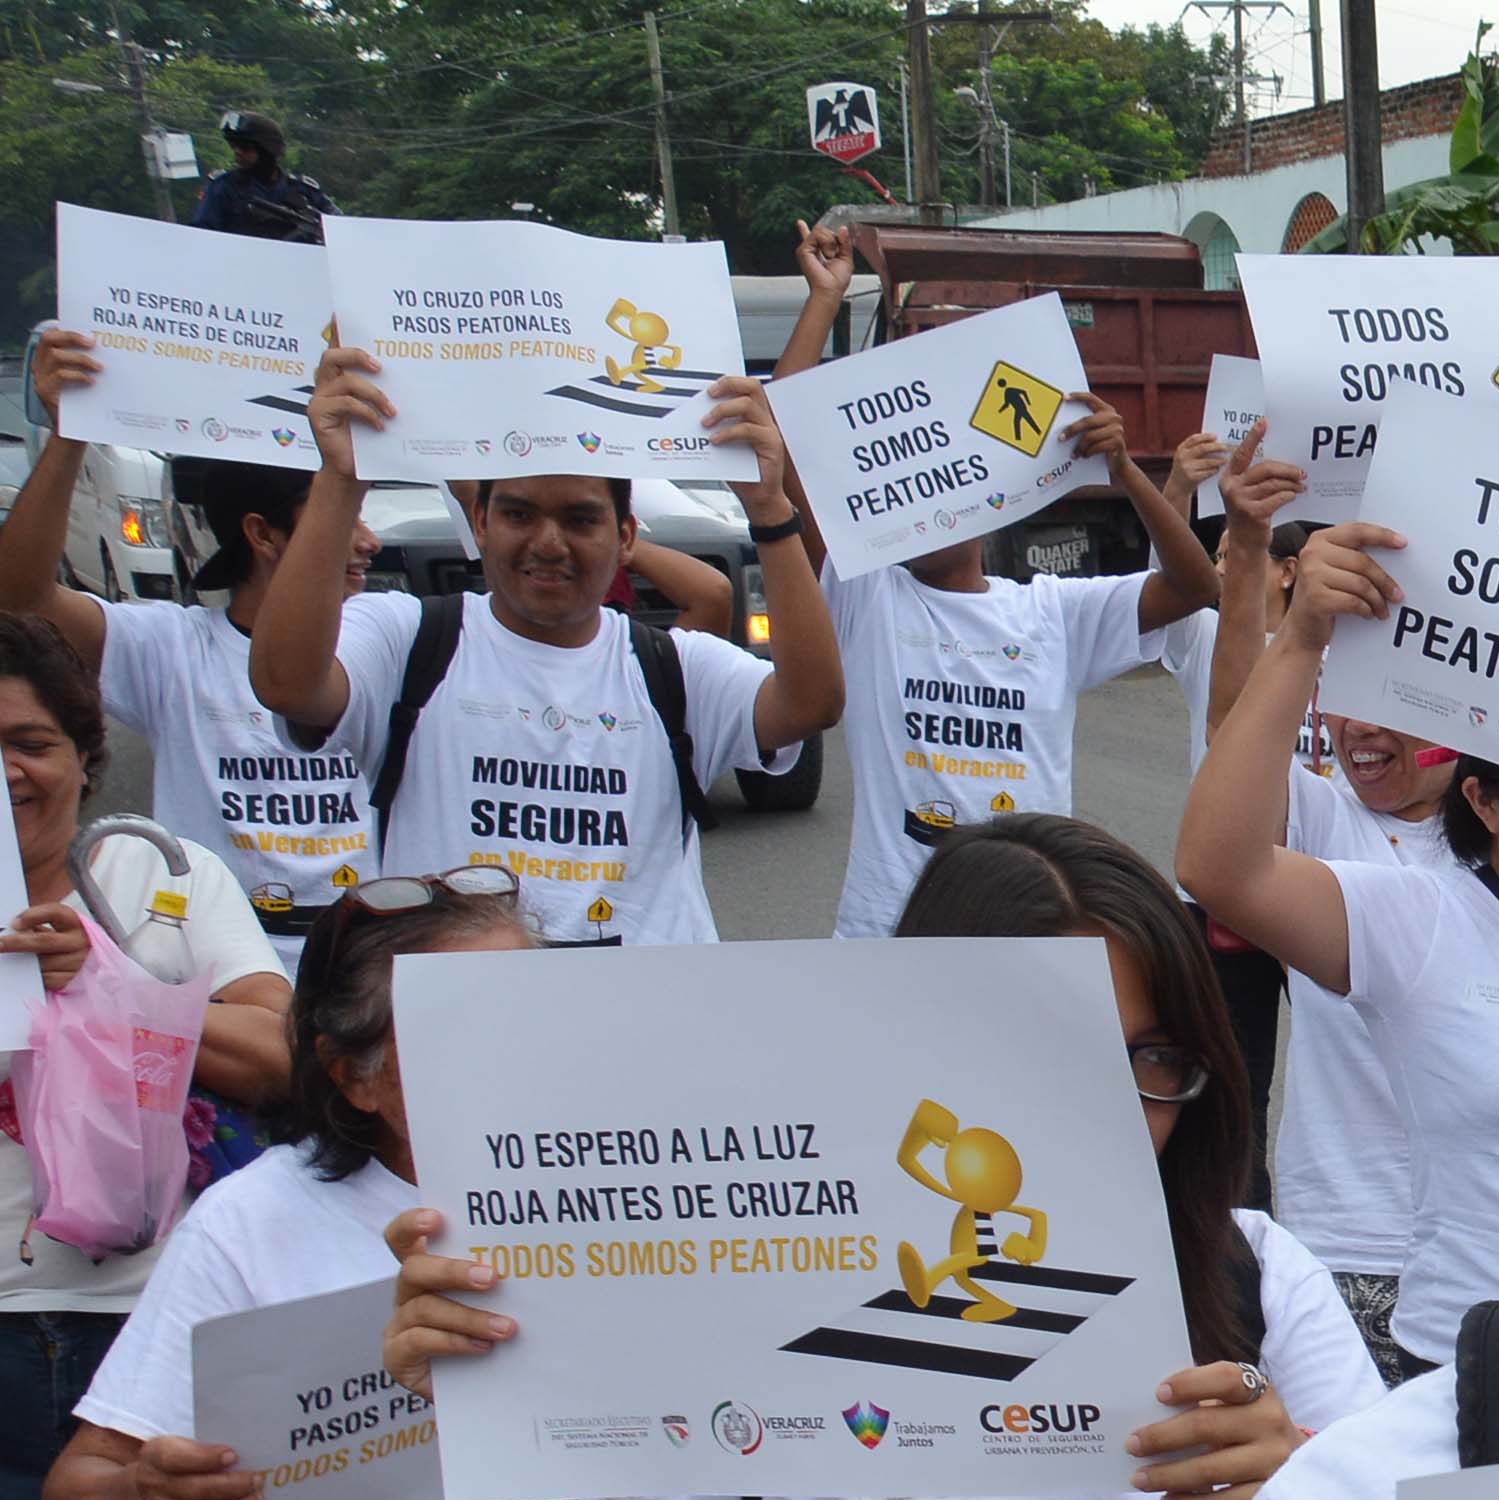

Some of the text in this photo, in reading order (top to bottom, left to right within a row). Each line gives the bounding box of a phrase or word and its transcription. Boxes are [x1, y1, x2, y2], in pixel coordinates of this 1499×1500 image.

[109, 286, 284, 329] YO ESPERO A LA LUZ
[393, 289, 563, 309] YO CRUZO POR LOS
[94, 307, 299, 353] ROJA ANTES DE CRUZAR
[392, 315, 572, 335] PASOS PEATONALES
[1328, 307, 1450, 343] TODOS
[91, 330, 305, 377] TODOS SOMOS PEATONES
[374, 339, 596, 364] TODOS SOMOS PEATONES
[838, 380, 931, 430] TODOS
[1224, 409, 1237, 423] YO
[853, 421, 950, 473] SOMOS
[846, 454, 989, 522] PEATONES
[1027, 539, 1089, 568] QUAKER
[1039, 553, 1082, 574] STATE
[904, 677, 1025, 711] MOVILIDAD
[905, 712, 1024, 752] SEGURA
[218, 756, 359, 782] MOVILIDAD
[472, 756, 627, 795] MOVILIDAD
[904, 750, 1027, 780] en Veracruz
[221, 791, 360, 825] SEGURA
[470, 799, 629, 847] SEGURA
[257, 831, 369, 857] Veracruz
[508, 851, 627, 882] Veracruz
[486, 1123, 820, 1169] YO ESPERO A LA LUZ
[467, 1179, 859, 1226] ROJA ANTES DE CRUZAR
[467, 1234, 878, 1280] TODOS SOMOS PEATONES
[297, 1370, 398, 1414] YO CRU
[291, 1405, 379, 1451] PASOS
[762, 1416, 825, 1430] VERACRUZ
[893, 1421, 956, 1436] Trabajamos
[979, 1404, 1100, 1433] CeSUP
[255, 1419, 436, 1490] TODOS SOMO
[897, 1437, 934, 1448] Juntos
[982, 1434, 1105, 1443] CENTRO DE SEGURIDAD
